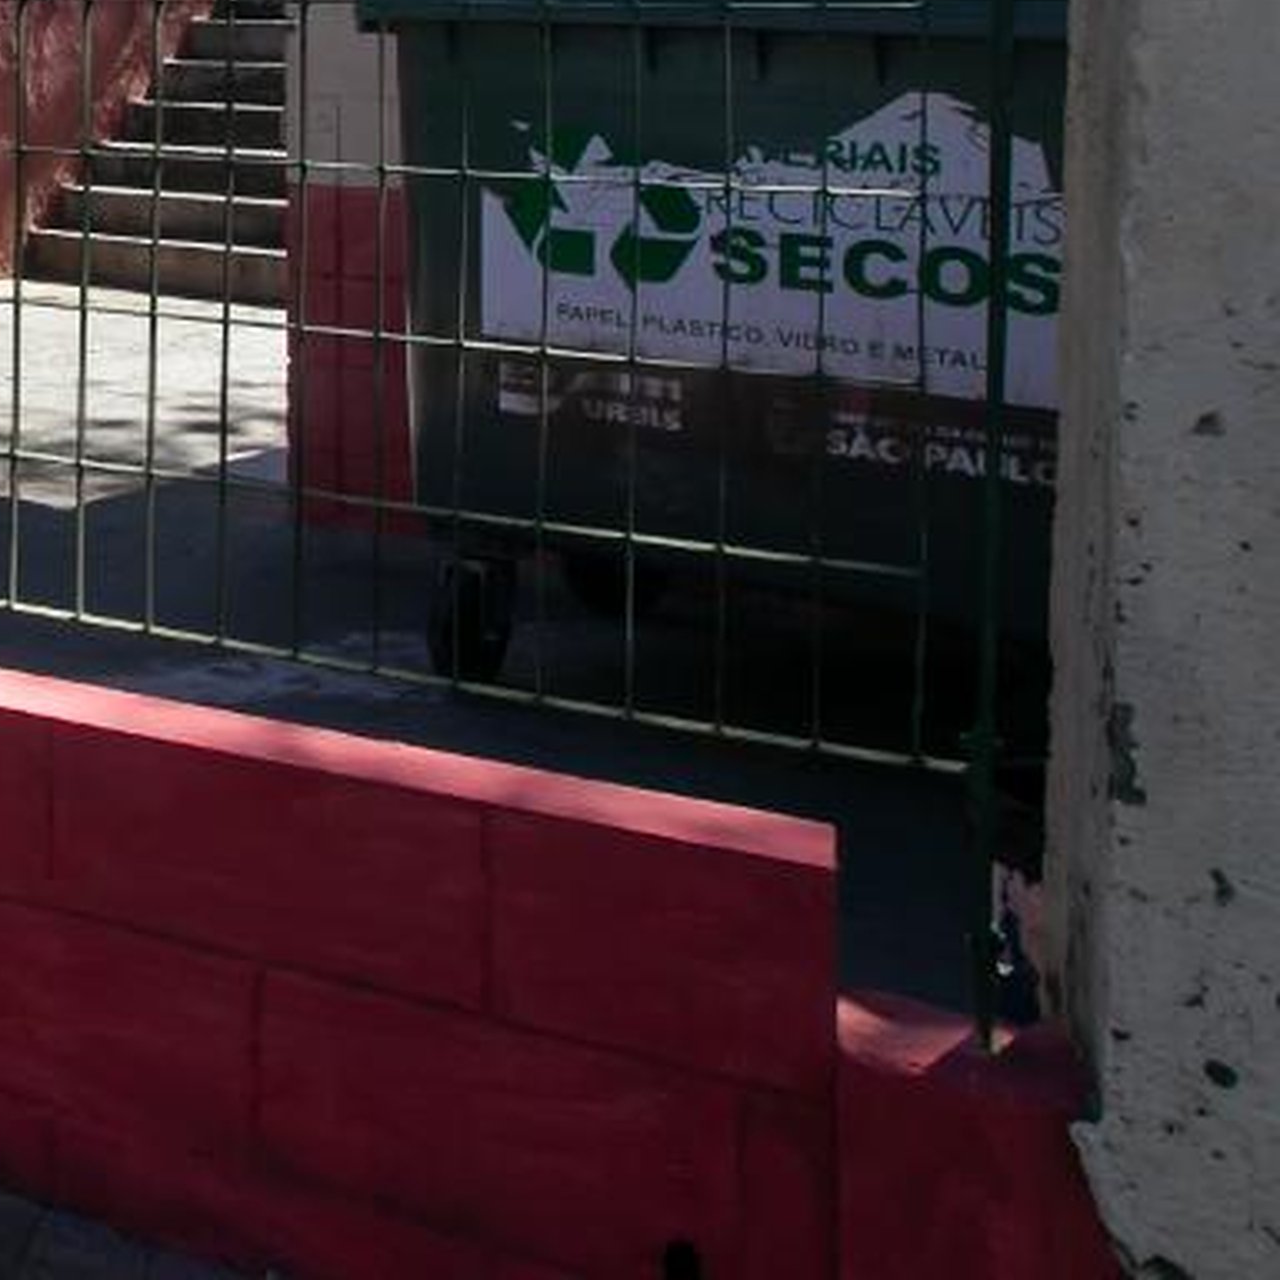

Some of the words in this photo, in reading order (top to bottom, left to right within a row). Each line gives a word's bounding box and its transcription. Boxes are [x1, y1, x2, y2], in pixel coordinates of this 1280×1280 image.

[712, 228, 1062, 316] SECOS
[641, 312, 772, 348] PLASTCO,
[867, 339, 884, 358] E
[891, 343, 988, 371] METAL
